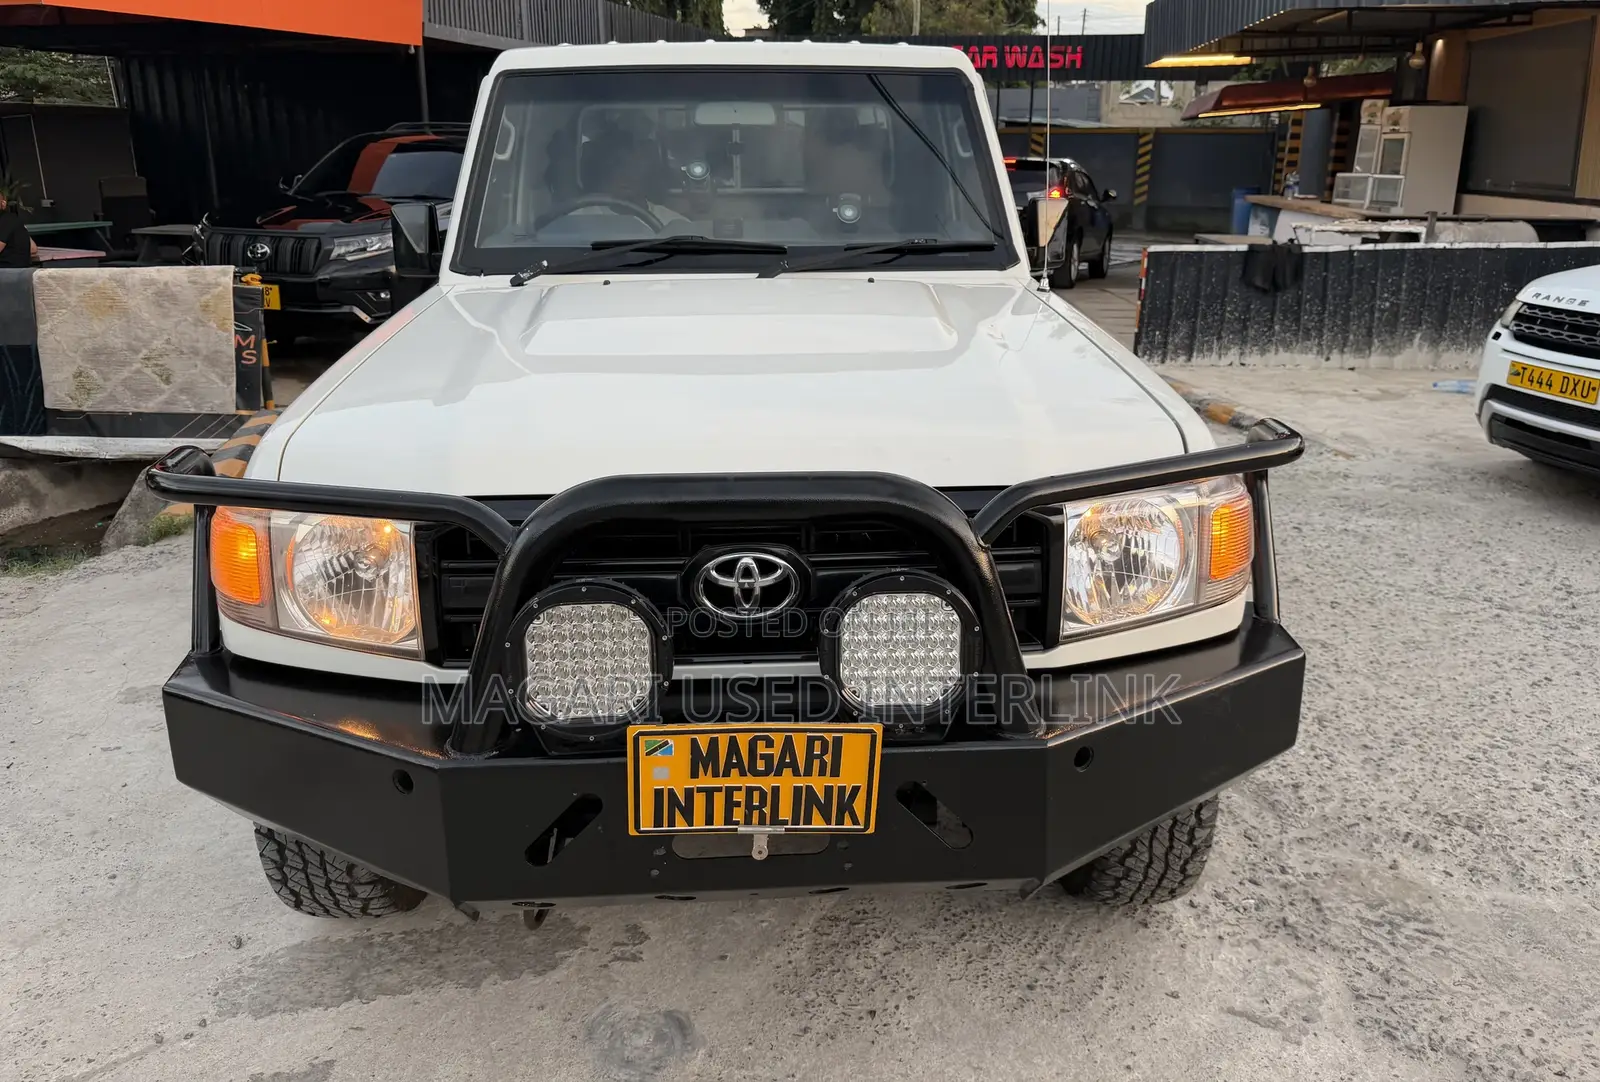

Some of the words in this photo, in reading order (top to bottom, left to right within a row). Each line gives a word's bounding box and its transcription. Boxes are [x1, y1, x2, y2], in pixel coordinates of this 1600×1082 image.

[953, 45, 998, 69] AR
[1004, 45, 1083, 69] WASH
[1532, 292, 1590, 307] RANGE
[1519, 366, 1554, 389] T444
[1560, 375, 1592, 399] DXU
[689, 733, 844, 780] MAGARI
[652, 783, 863, 829] INTERLINK
